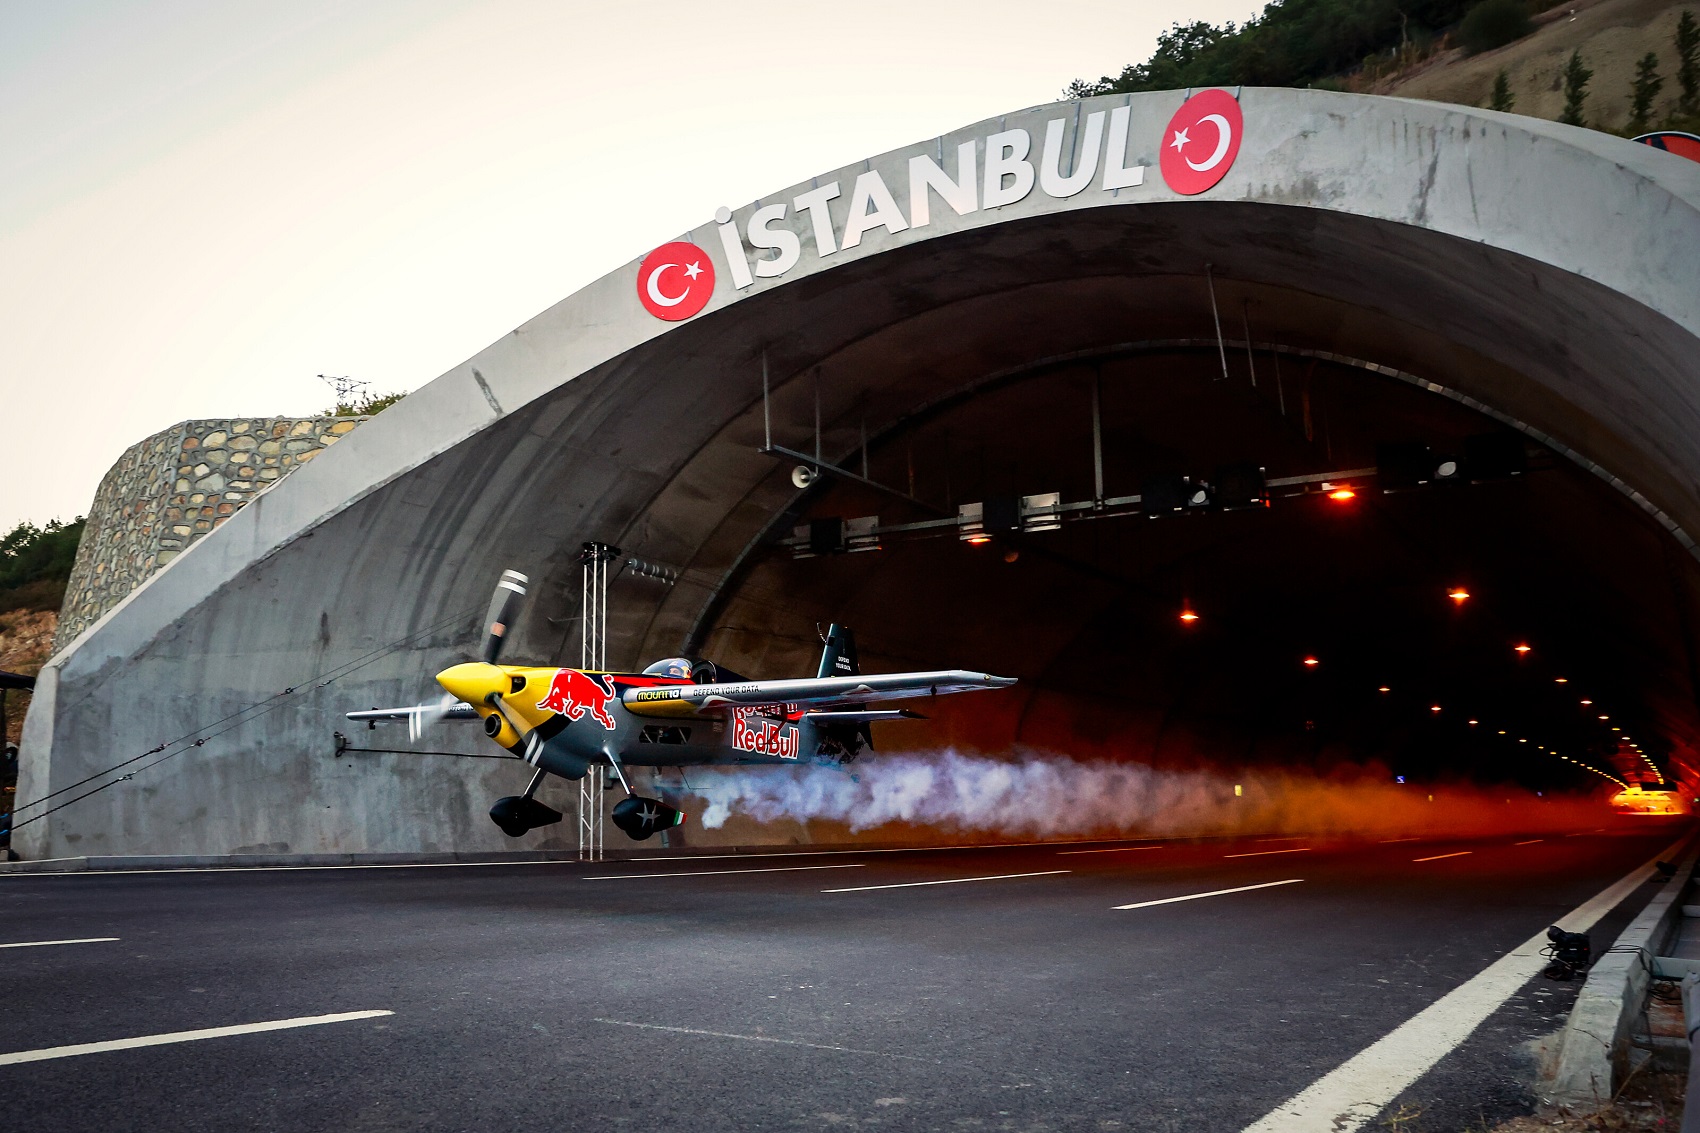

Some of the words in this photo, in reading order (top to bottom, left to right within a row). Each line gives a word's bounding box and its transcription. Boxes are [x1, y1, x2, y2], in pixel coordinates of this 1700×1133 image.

[715, 105, 1144, 291] İSTANBUL
[693, 687, 720, 697] DEFEND
[721, 686, 741, 695] YOUR
[732, 718, 767, 754] Red
